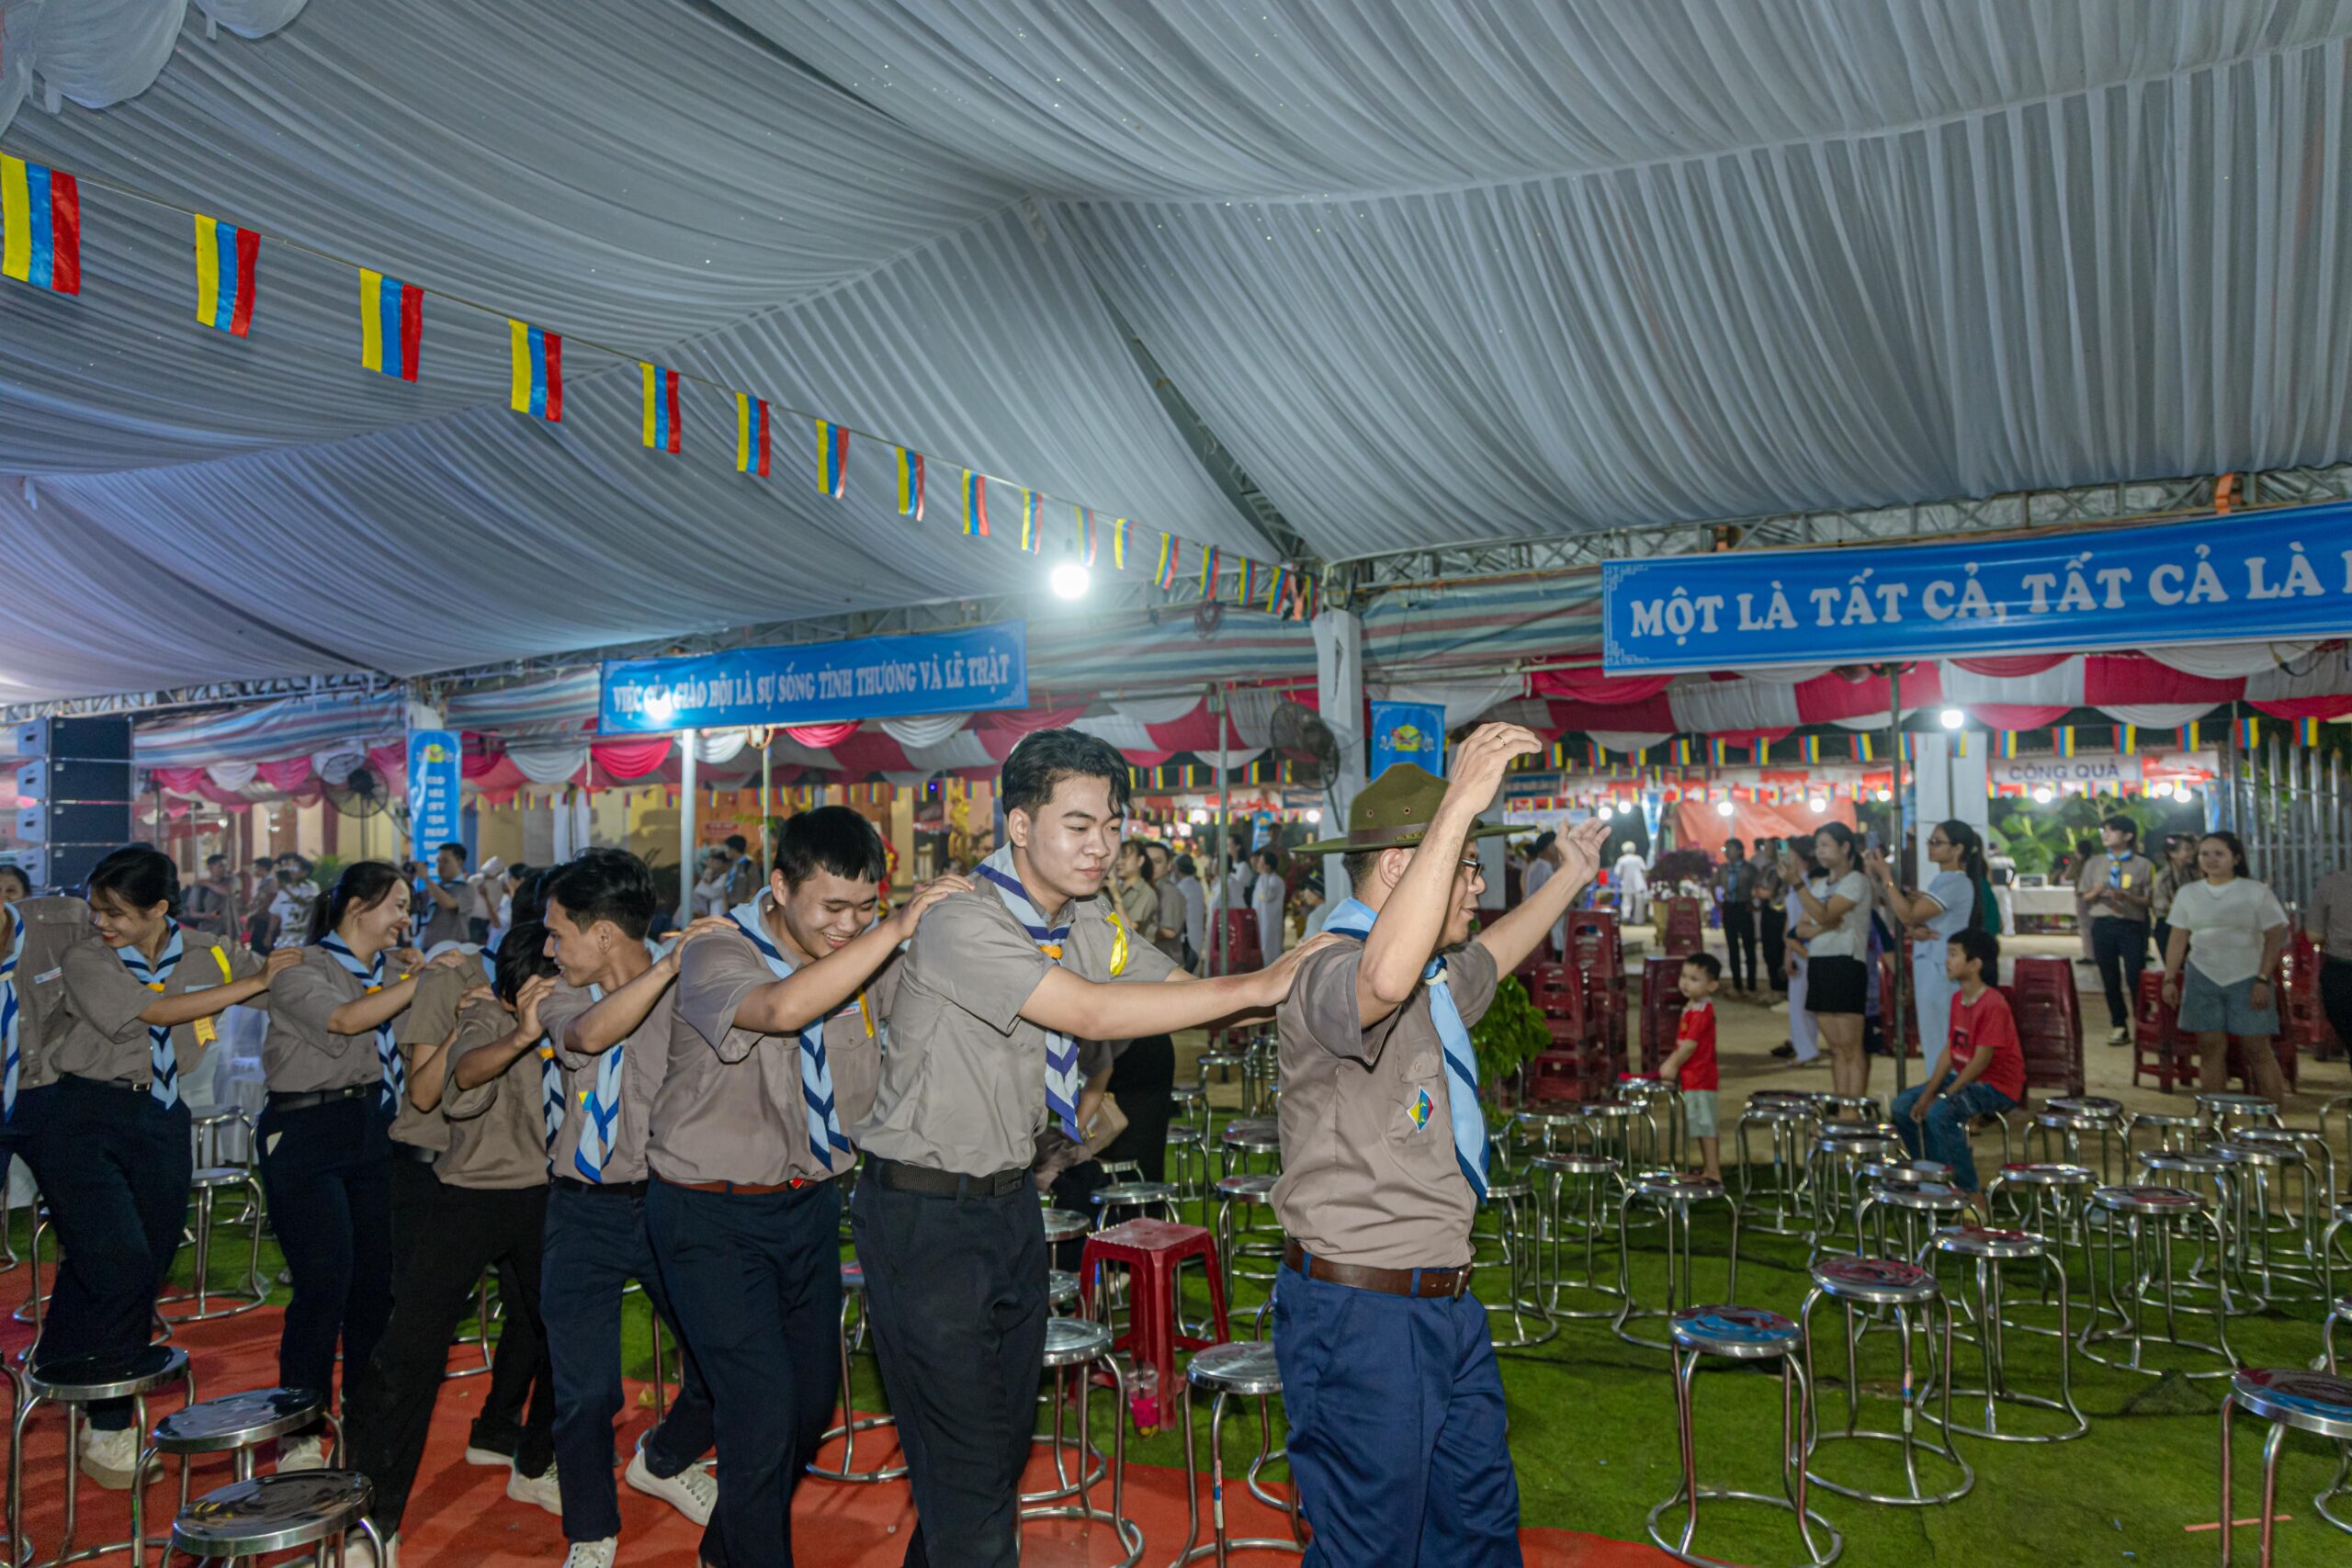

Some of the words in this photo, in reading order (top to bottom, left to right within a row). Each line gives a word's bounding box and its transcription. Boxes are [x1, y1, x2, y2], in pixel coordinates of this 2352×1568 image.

[1631, 586, 1724, 645] MỘT
[1736, 581, 1798, 631] LÀ
[1810, 568, 1908, 626] TẤT
[1923, 561, 2007, 624] CẢ,
[2022, 551, 2132, 613] TẤT
[2148, 544, 2229, 605] CẢ
[2245, 541, 2325, 600] LÀ
[707, 671, 733, 714] HỘI
[735, 670, 753, 705] LÀ
[757, 671, 775, 712] SỰ
[778, 661, 815, 703] SỐNG
[819, 663, 853, 699] TÌNH
[855, 659, 917, 696] THƯƠNG
[919, 653, 942, 690] VÀ
[967, 646, 1009, 694] THẬT
[2009, 762, 2068, 780] CÔNG
